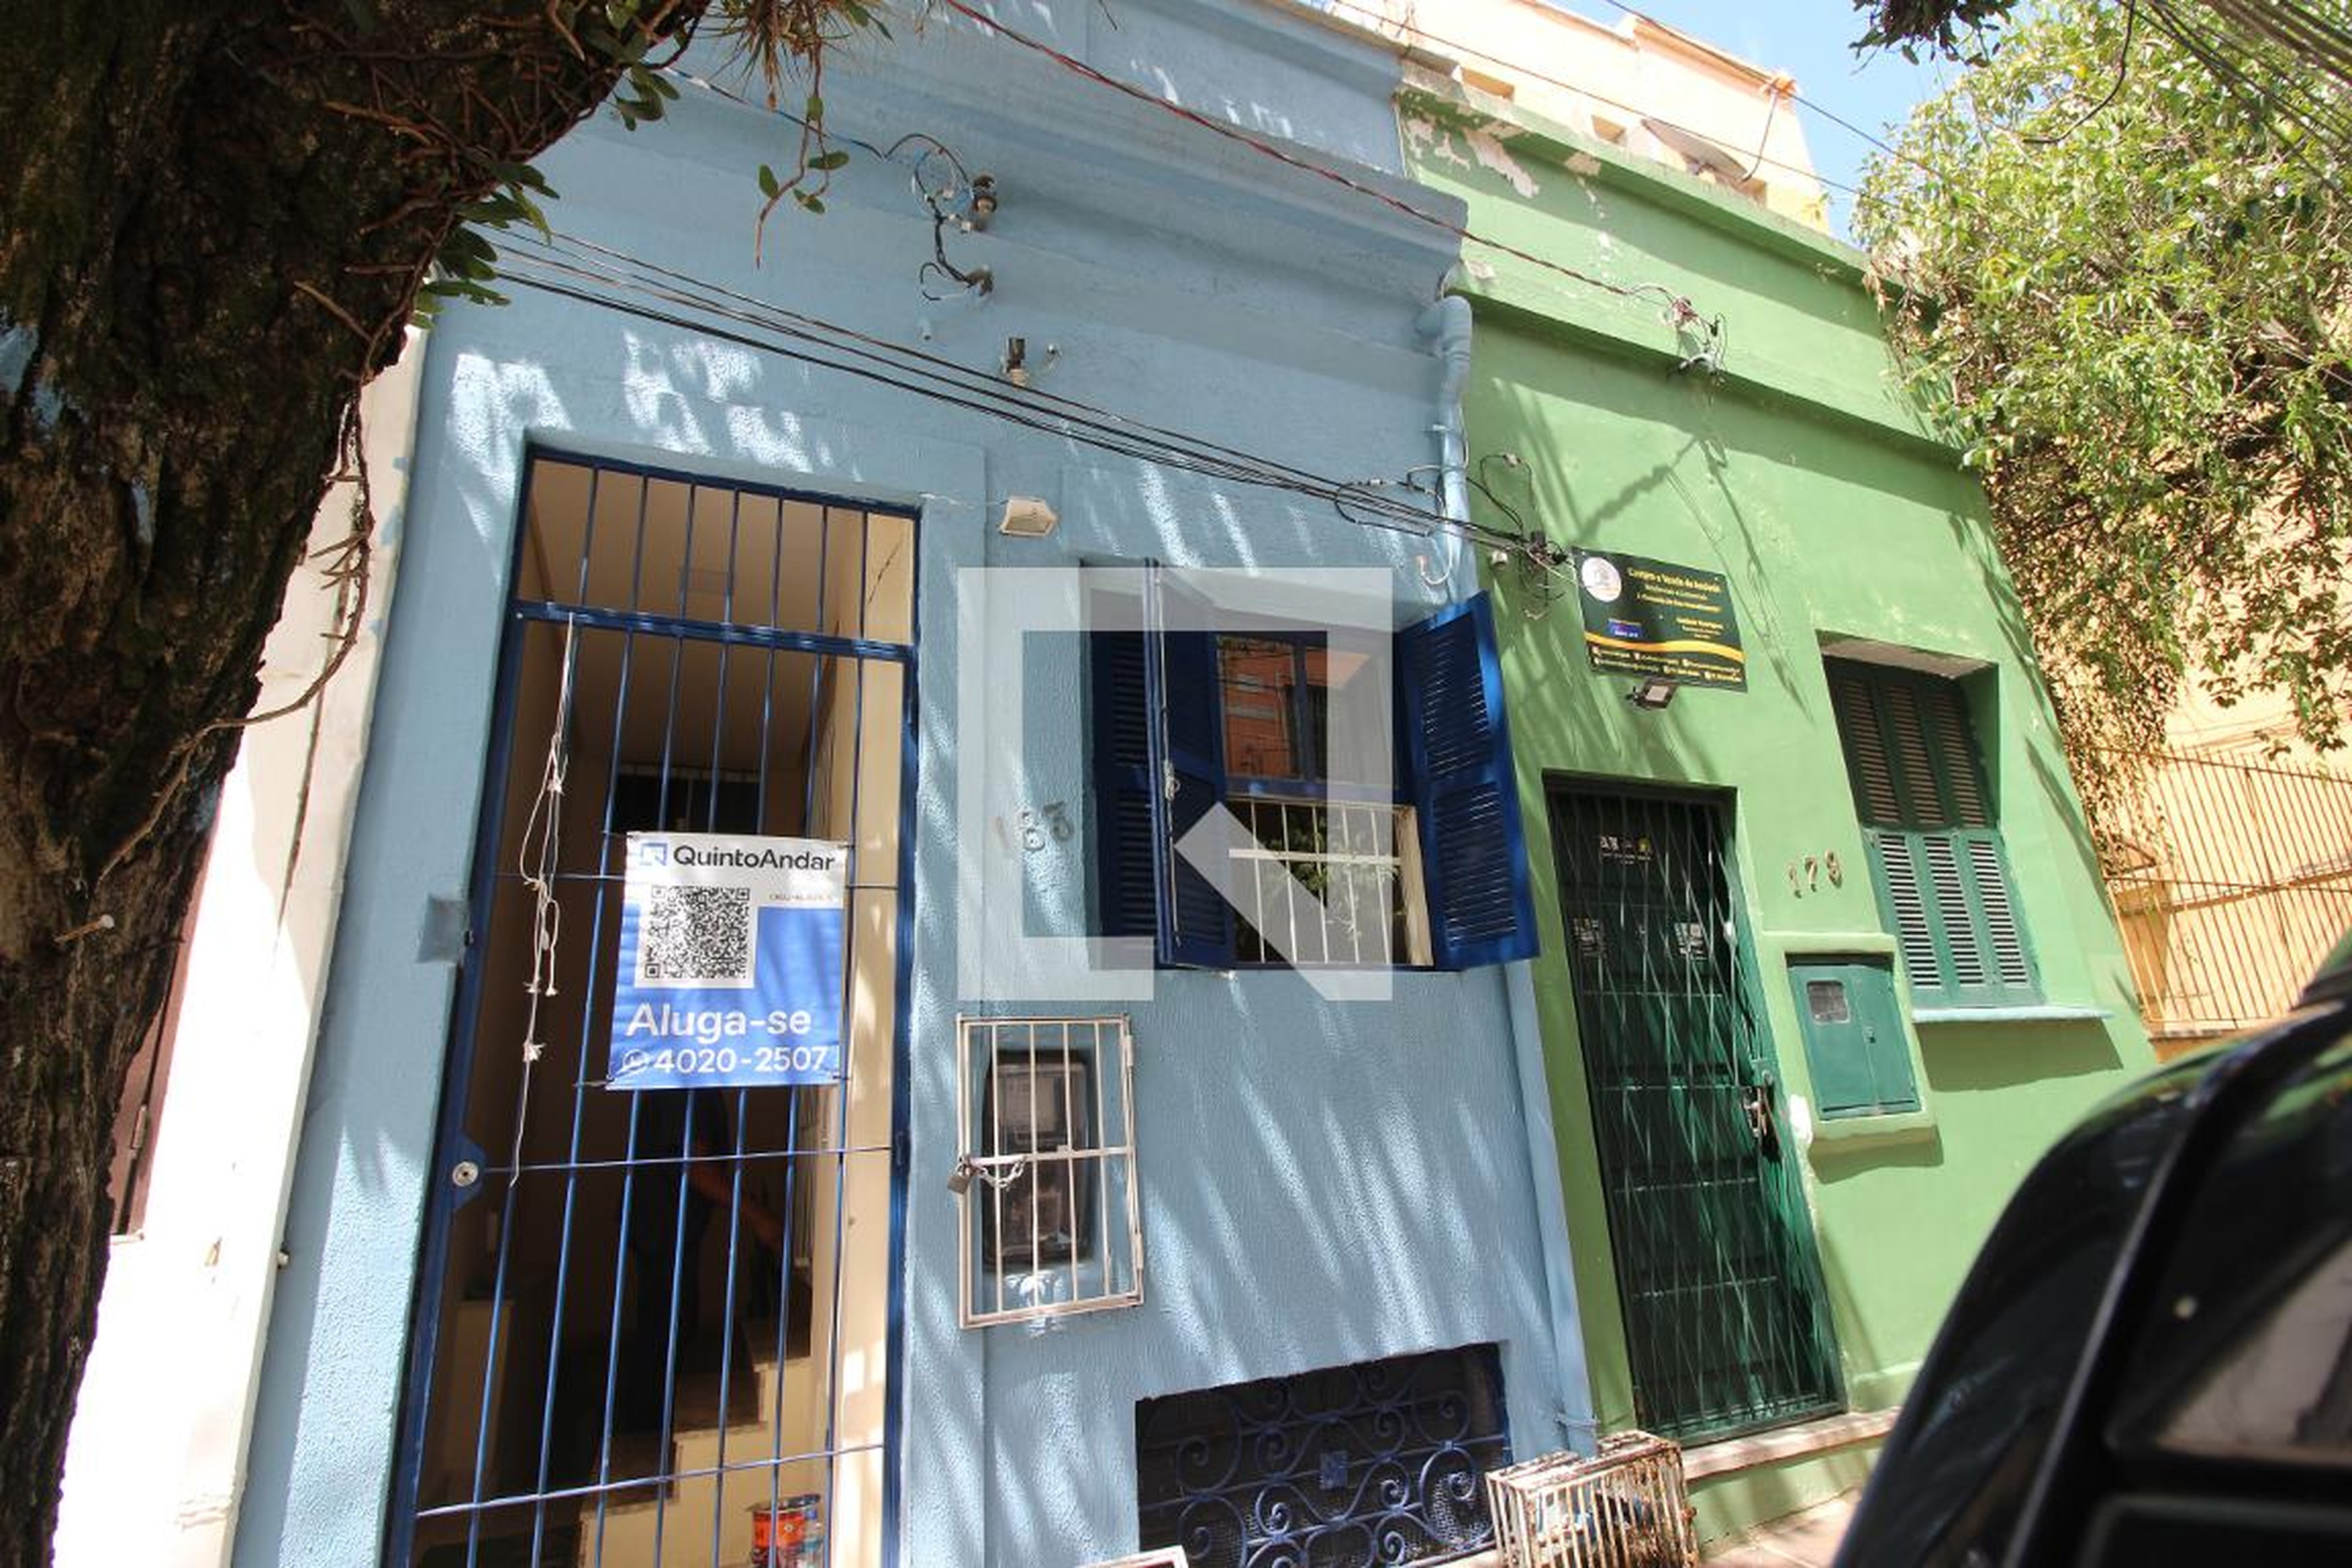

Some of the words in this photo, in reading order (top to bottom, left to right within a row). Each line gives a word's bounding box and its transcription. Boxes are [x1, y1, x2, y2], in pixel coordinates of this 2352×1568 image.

[673, 845, 835, 870] QuintoAndar
[625, 1003, 812, 1044] Aluga-se
[652, 1046, 828, 1074] 4020-2507
